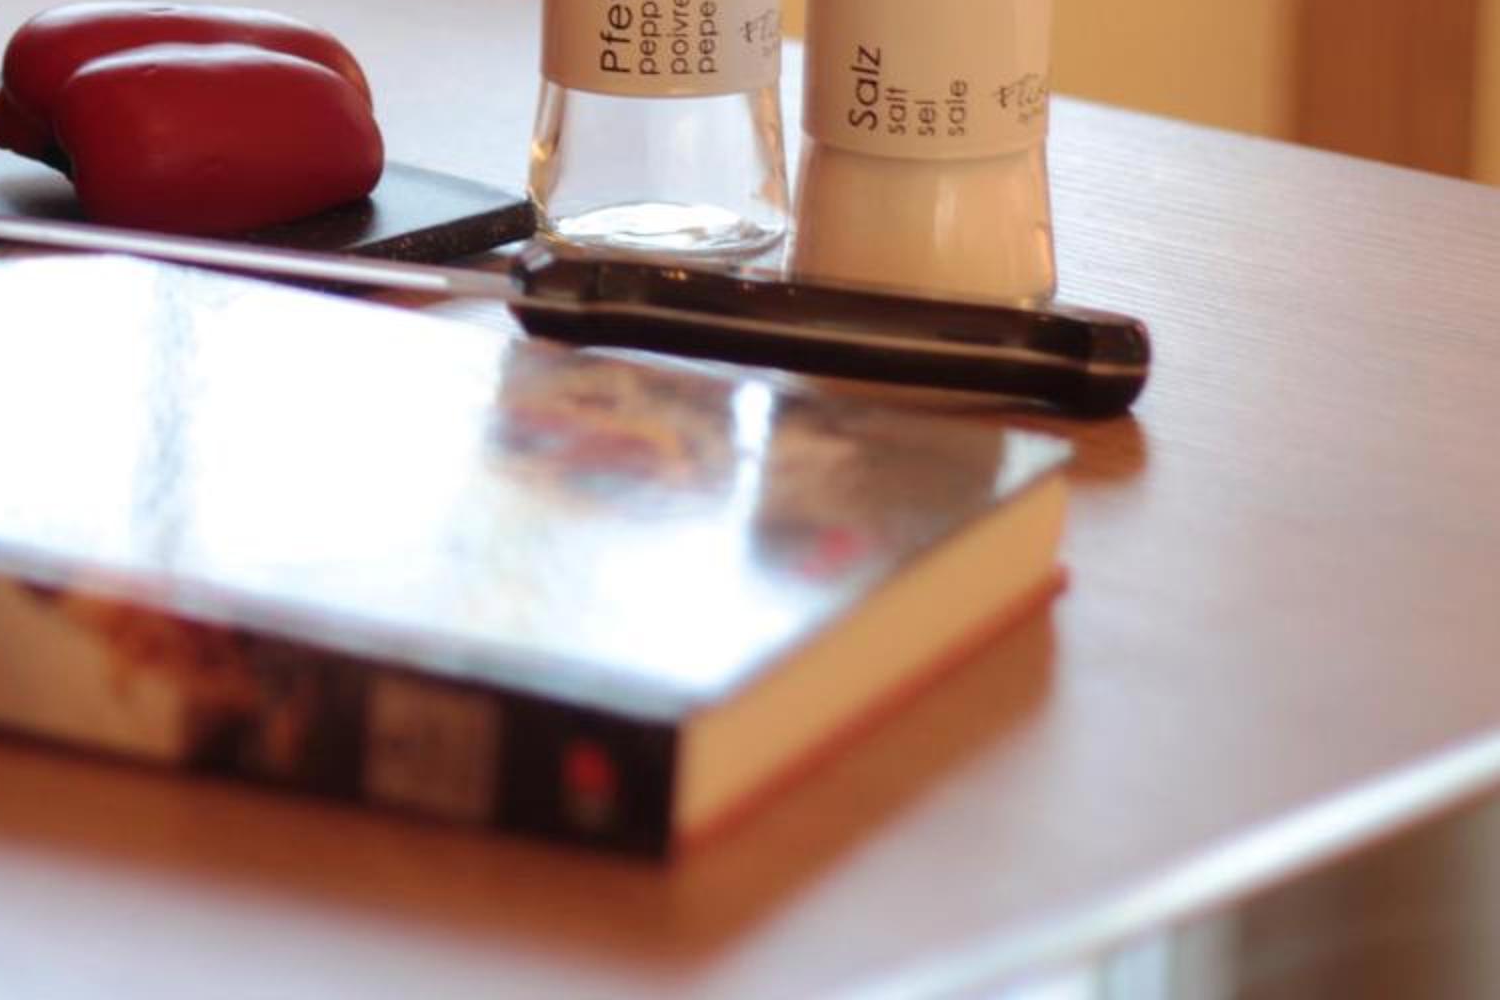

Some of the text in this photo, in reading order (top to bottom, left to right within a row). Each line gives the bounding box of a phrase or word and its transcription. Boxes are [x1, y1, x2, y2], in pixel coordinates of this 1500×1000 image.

[698, 1, 718, 74] pepe
[848, 45, 881, 131] Salz
[885, 87, 907, 134] salt
[946, 80, 968, 136] sale
[915, 100, 936, 136] sel
